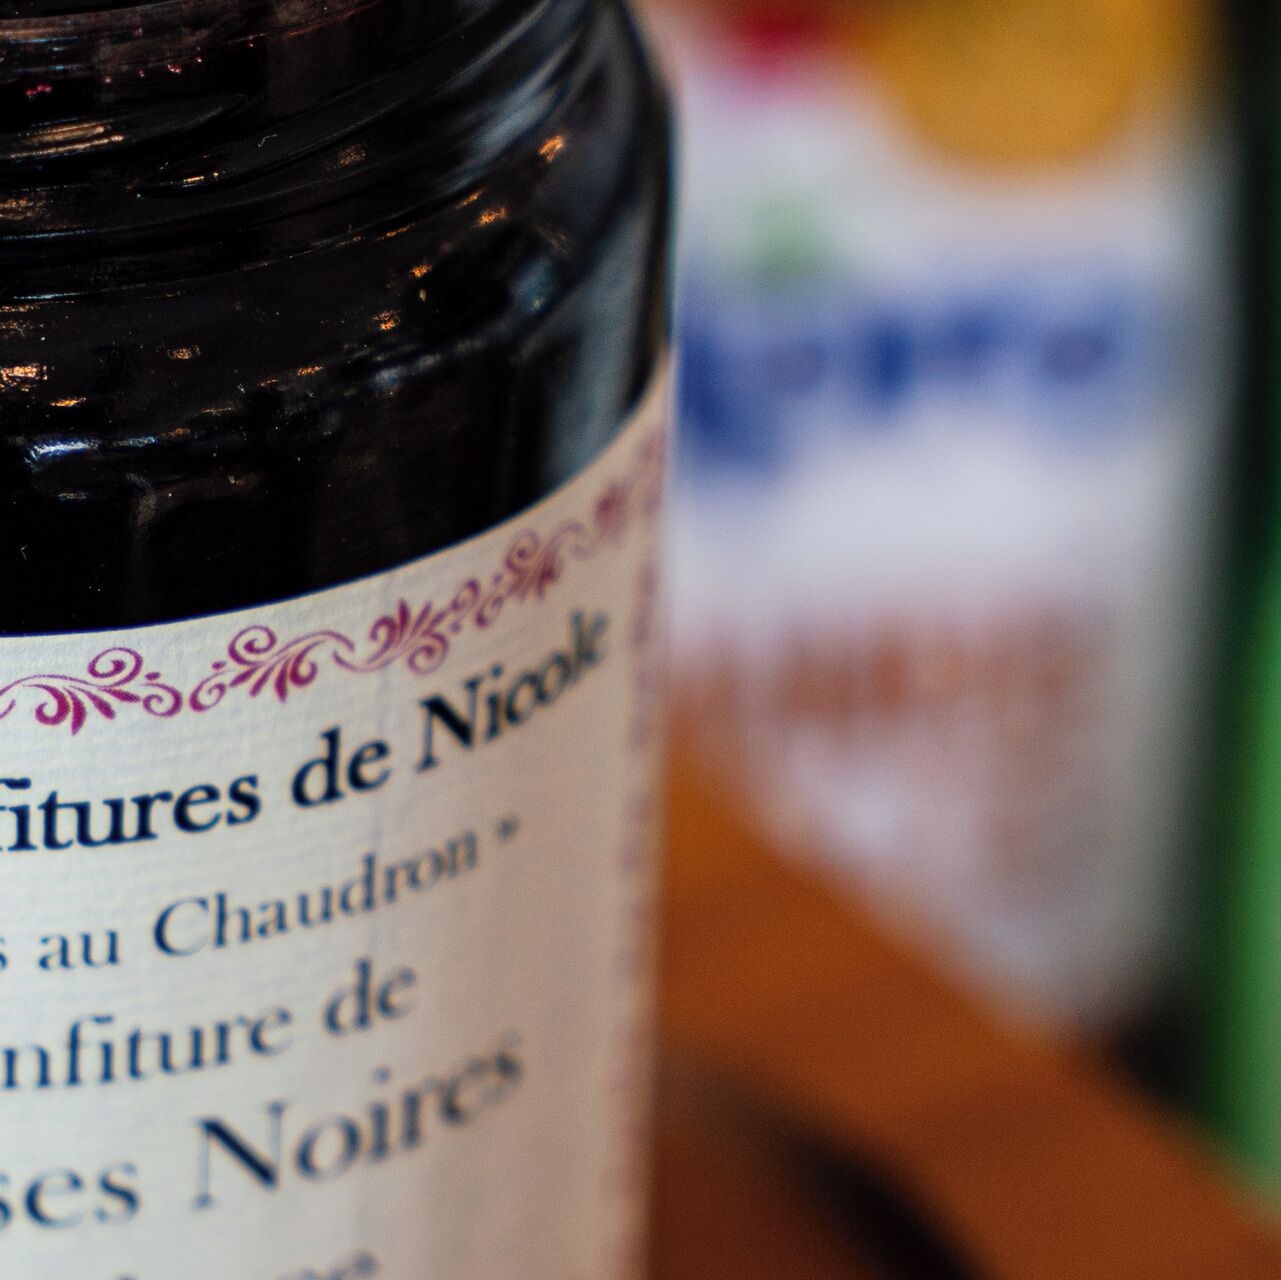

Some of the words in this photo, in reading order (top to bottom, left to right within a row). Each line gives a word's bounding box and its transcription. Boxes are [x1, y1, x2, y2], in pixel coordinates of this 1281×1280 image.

[291, 727, 391, 809] de
[416, 609, 608, 774] Nicole
[38, 929, 119, 971] au
[153, 832, 478, 958] Chaudron
[323, 957, 417, 1036] de
[192, 1033, 523, 1211] Noires
